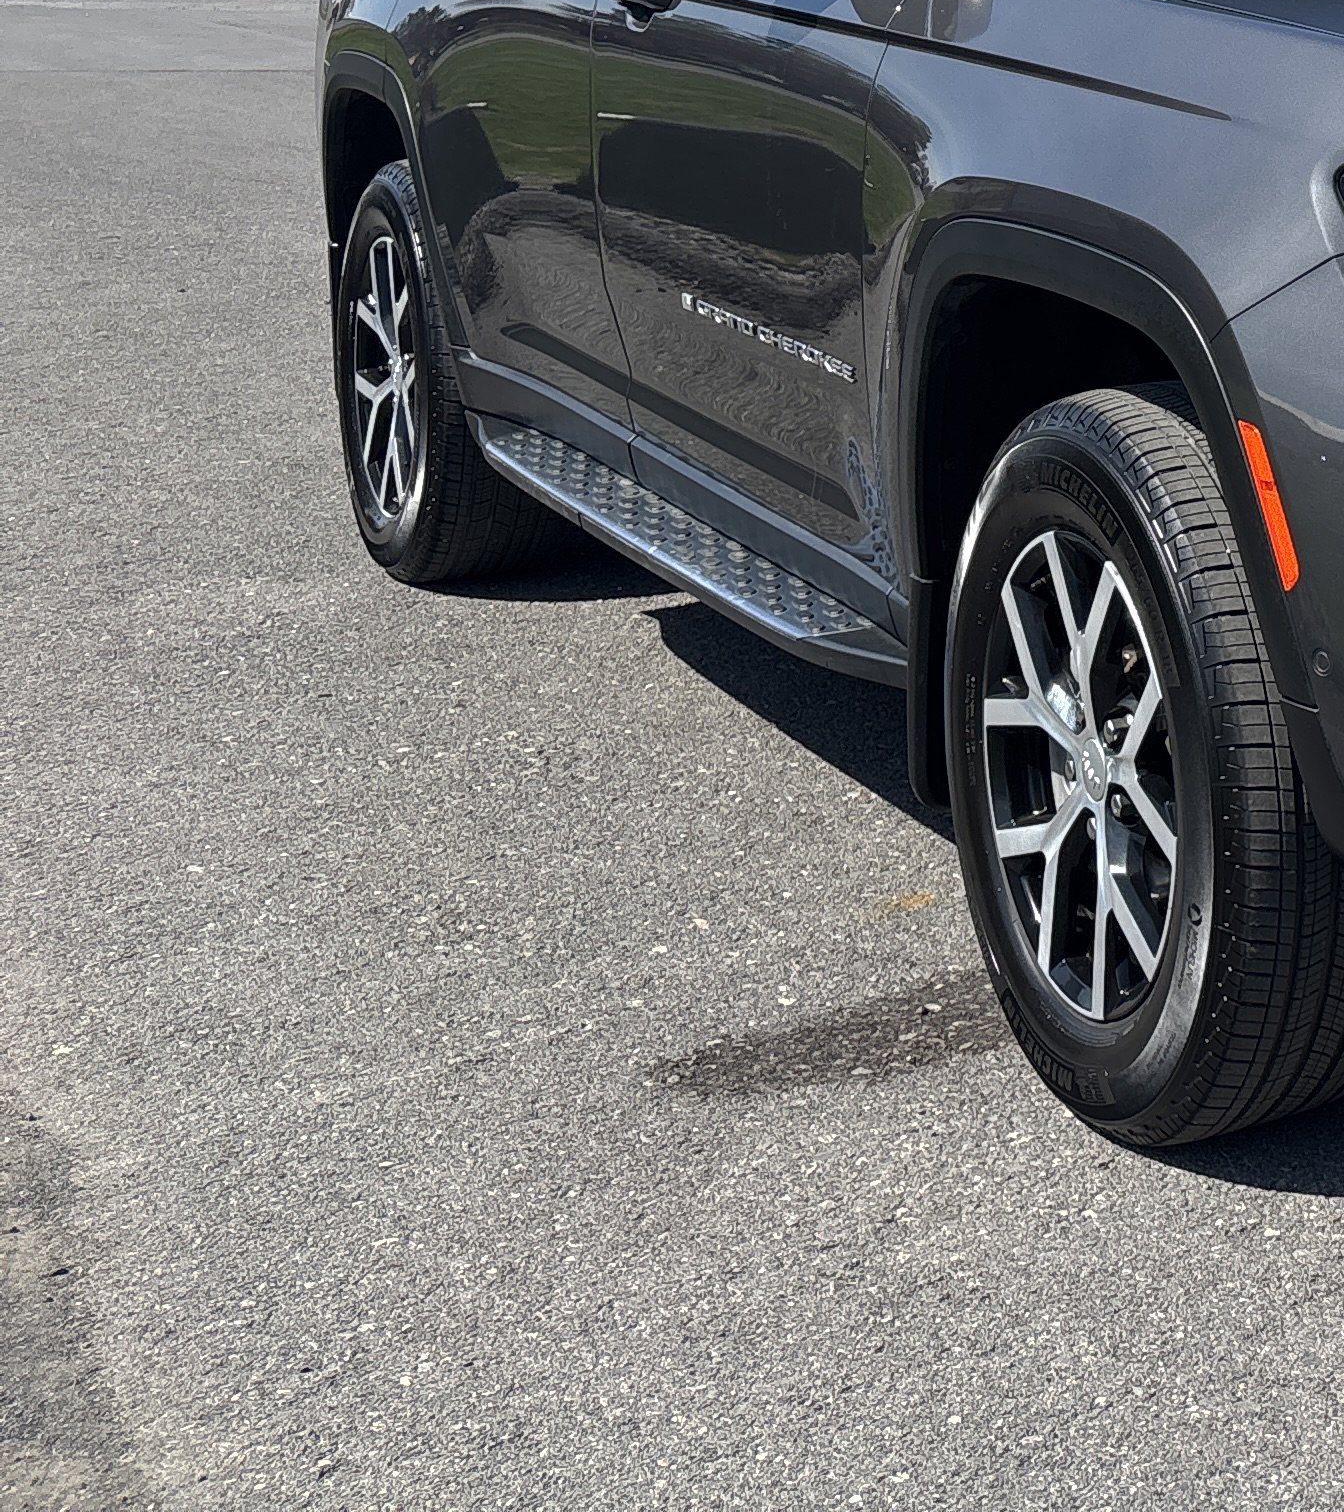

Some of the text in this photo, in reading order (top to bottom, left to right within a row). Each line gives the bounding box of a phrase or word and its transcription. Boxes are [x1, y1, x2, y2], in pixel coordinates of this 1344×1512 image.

[696, 299, 859, 384] GRAND CHEROKEE
[1040, 461, 1119, 539] MICHELIN
[1003, 995, 1075, 1093] MICHELIN
